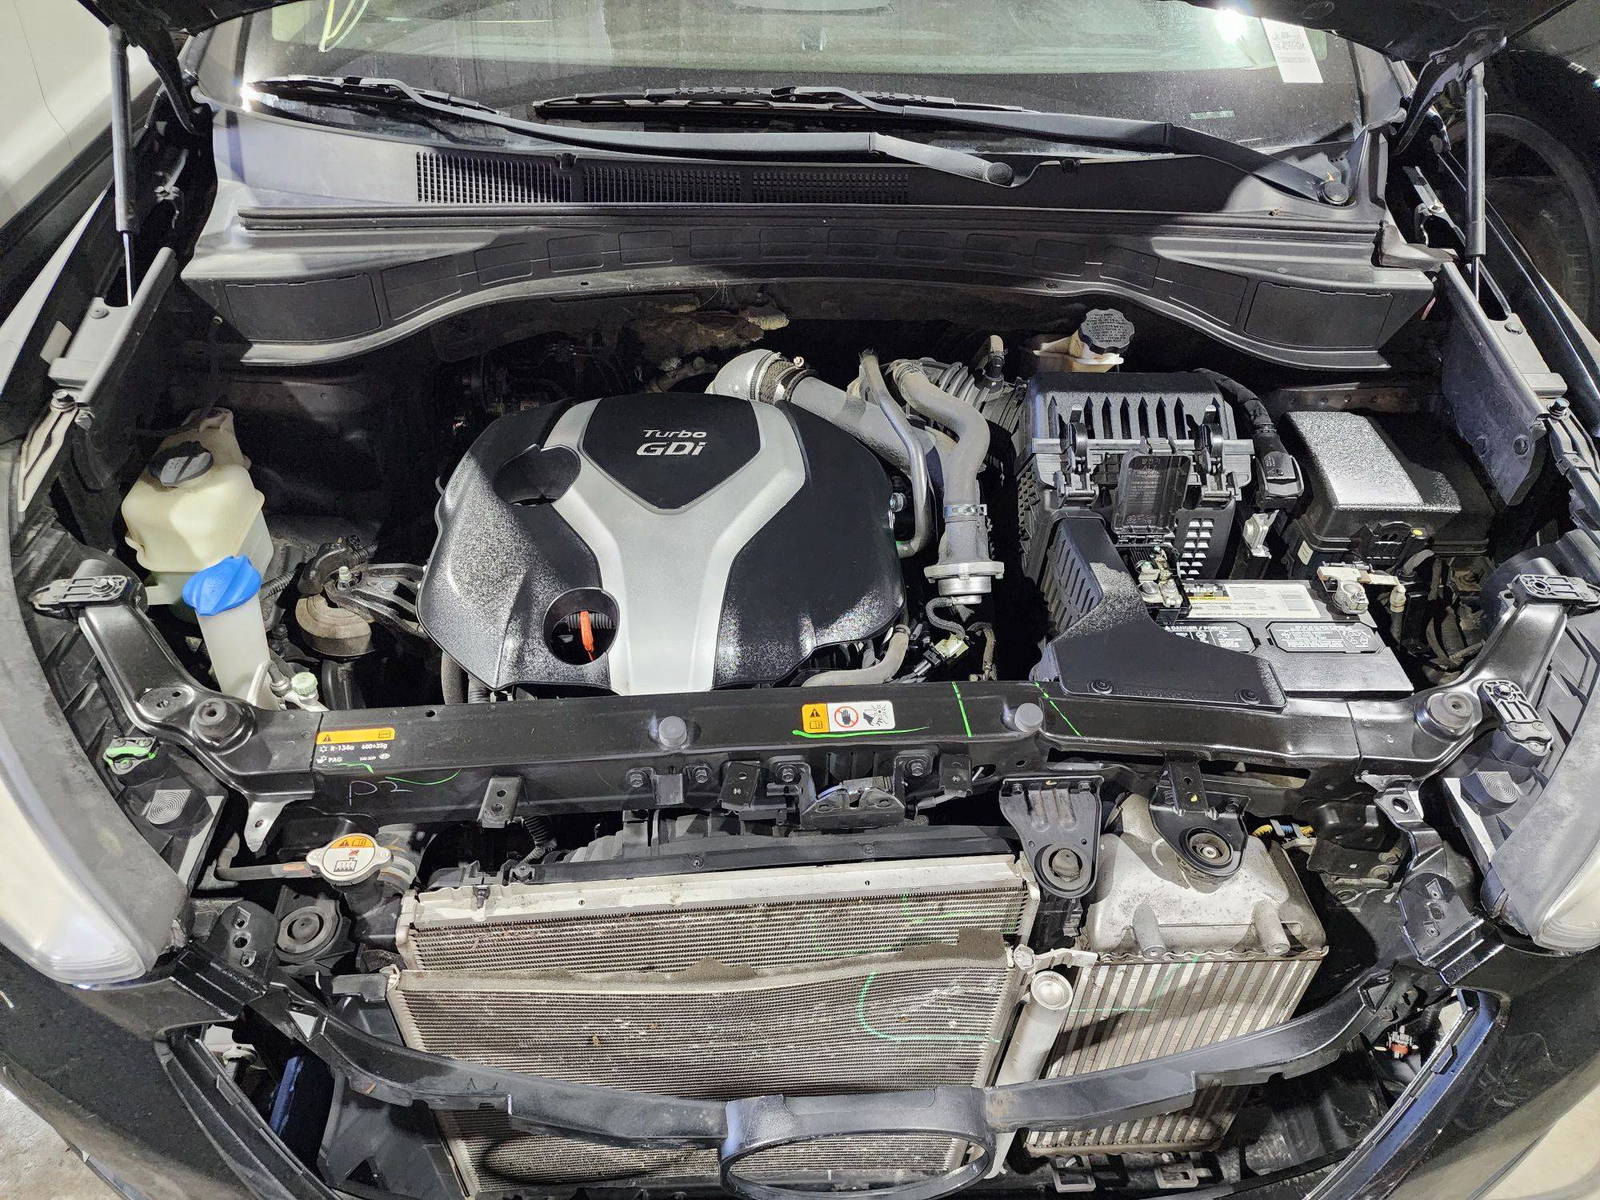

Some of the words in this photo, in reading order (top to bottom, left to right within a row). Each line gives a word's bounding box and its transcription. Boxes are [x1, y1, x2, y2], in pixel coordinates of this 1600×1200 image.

[642, 429, 707, 438] Turbo
[636, 441, 708, 456] GDi
[330, 744, 355, 752] R-134a
